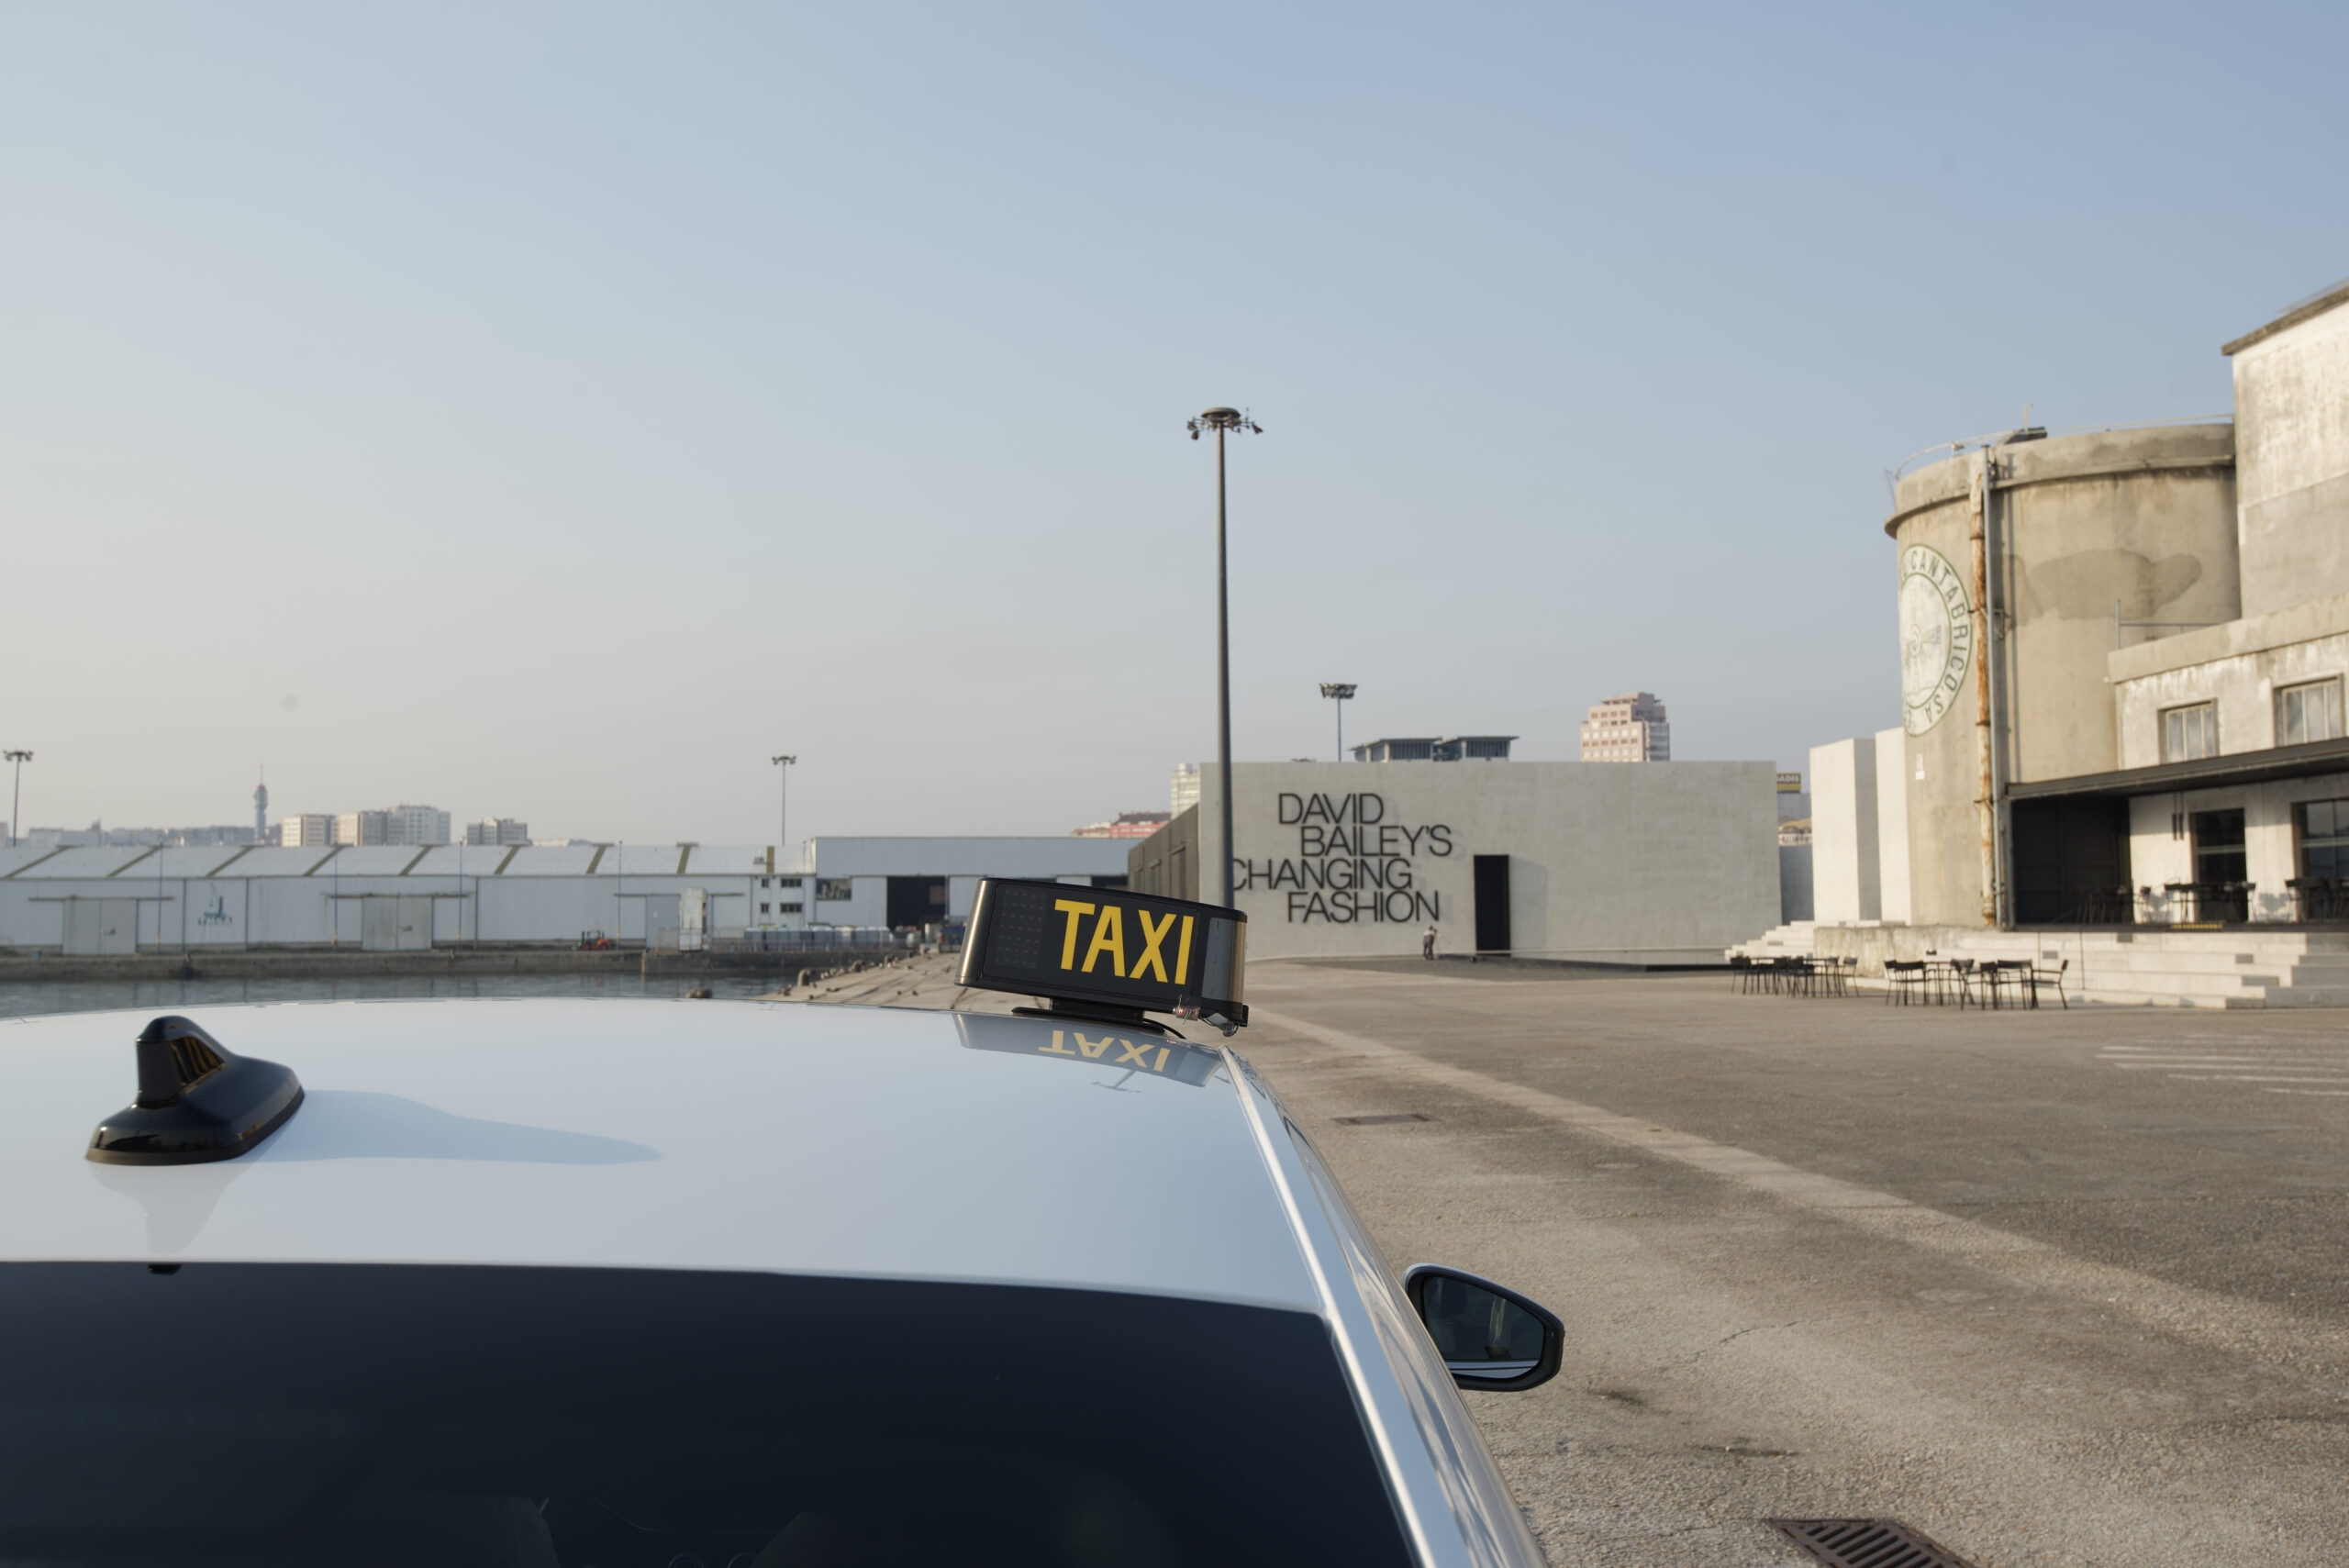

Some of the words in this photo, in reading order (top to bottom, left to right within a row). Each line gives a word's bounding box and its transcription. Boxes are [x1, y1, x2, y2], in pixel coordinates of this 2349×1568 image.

[1278, 793, 1384, 824] DAVID
[1301, 825, 1453, 856] BAILEY'S
[1288, 890, 1439, 923] FASHION
[1054, 898, 1195, 985] TAXI
